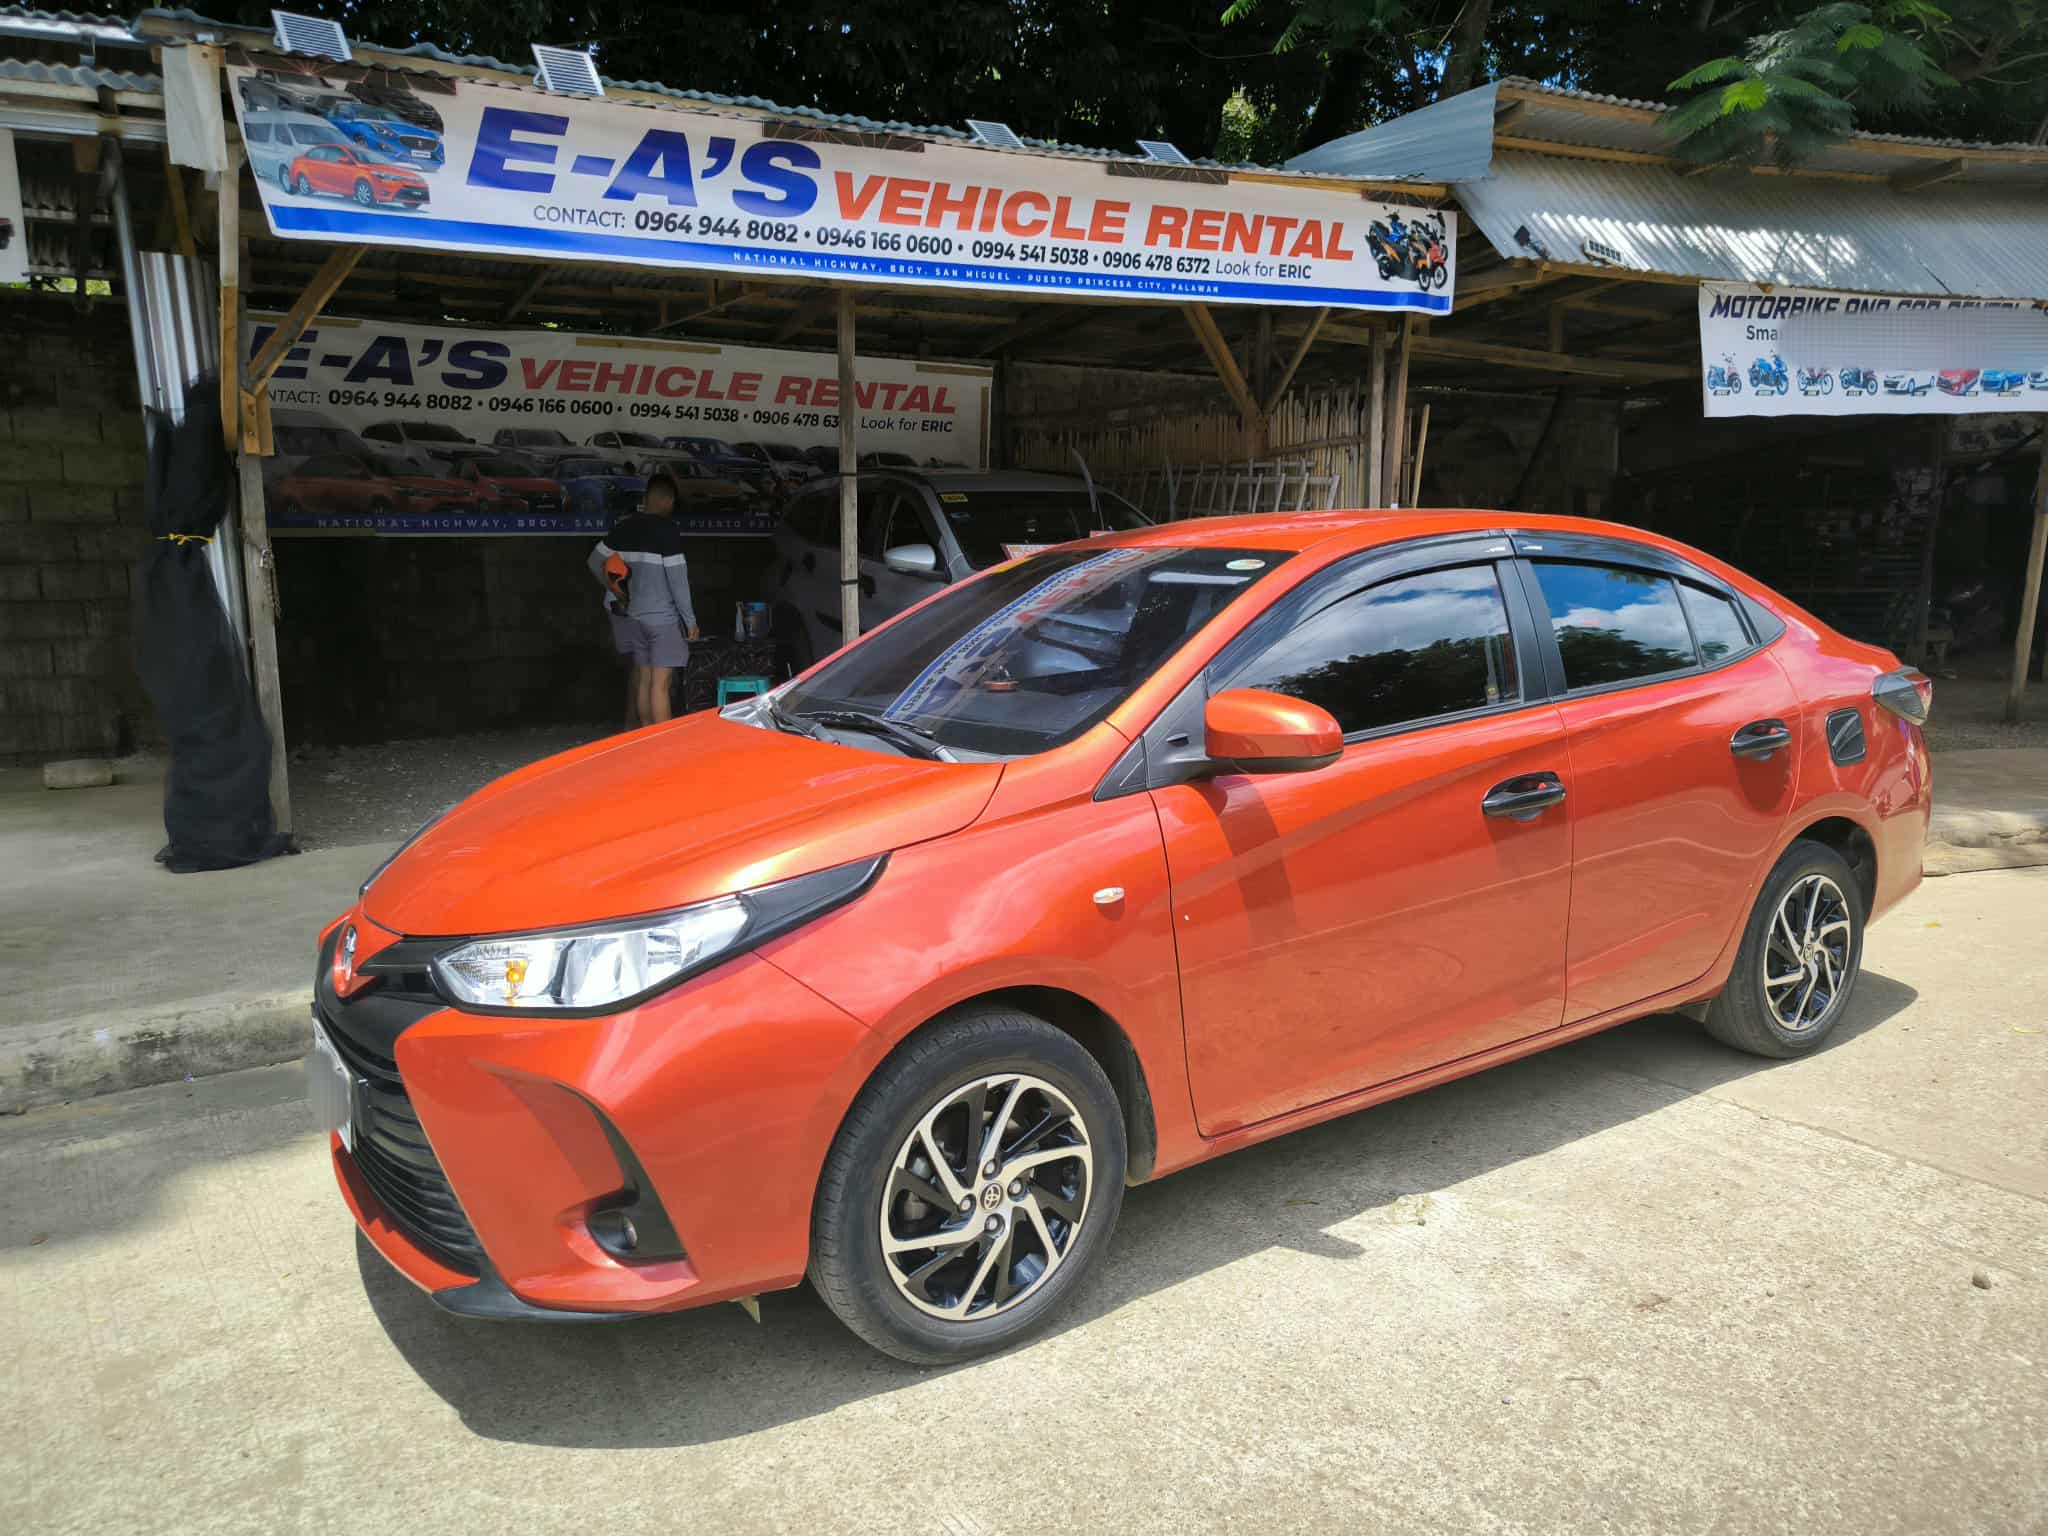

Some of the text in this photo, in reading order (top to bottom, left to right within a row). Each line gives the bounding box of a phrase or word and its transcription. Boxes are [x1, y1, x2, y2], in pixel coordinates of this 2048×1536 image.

[466, 107, 1354, 261] E-A'S VEHICLE RENTAL
[534, 205, 1312, 279] CONTACT: 0964 944 8082 0946 166 0600 0994 541 5038 0906 478 6372 Look for ERIC
[733, 252, 806, 266] NATIONAL
[814, 259, 882, 273] HIGHWAY,
[935, 267, 958, 277] SAN
[966, 270, 1010, 281] MIGUEL
[1028, 273, 1071, 285] PUERTO
[1078, 277, 1131, 288] PRINCESA
[1171, 283, 1219, 293] PALAWAN
[1709, 295, 1840, 319] MOTORBIKE
[520, 358, 763, 401] VEHICLE
[774, 376, 956, 414] RENTAL
[329, 390, 378, 406] 0964
[384, 392, 421, 408] 944
[427, 394, 472, 410] 8082
[489, 397, 533, 412] 0946
[539, 399, 565, 413] 166
[571, 400, 613, 415] 0600
[630, 404, 671, 418] 0994
[675, 406, 699, 420] 541
[703, 407, 738, 422] 5038
[753, 411, 789, 425] 0906
[793, 413, 819, 426] 478
[823, 415, 839, 428] 63
[861, 417, 894, 430] Look
[898, 418, 918, 431] for
[921, 420, 952, 433] ERIC
[318, 518, 409, 528] NATIONAL
